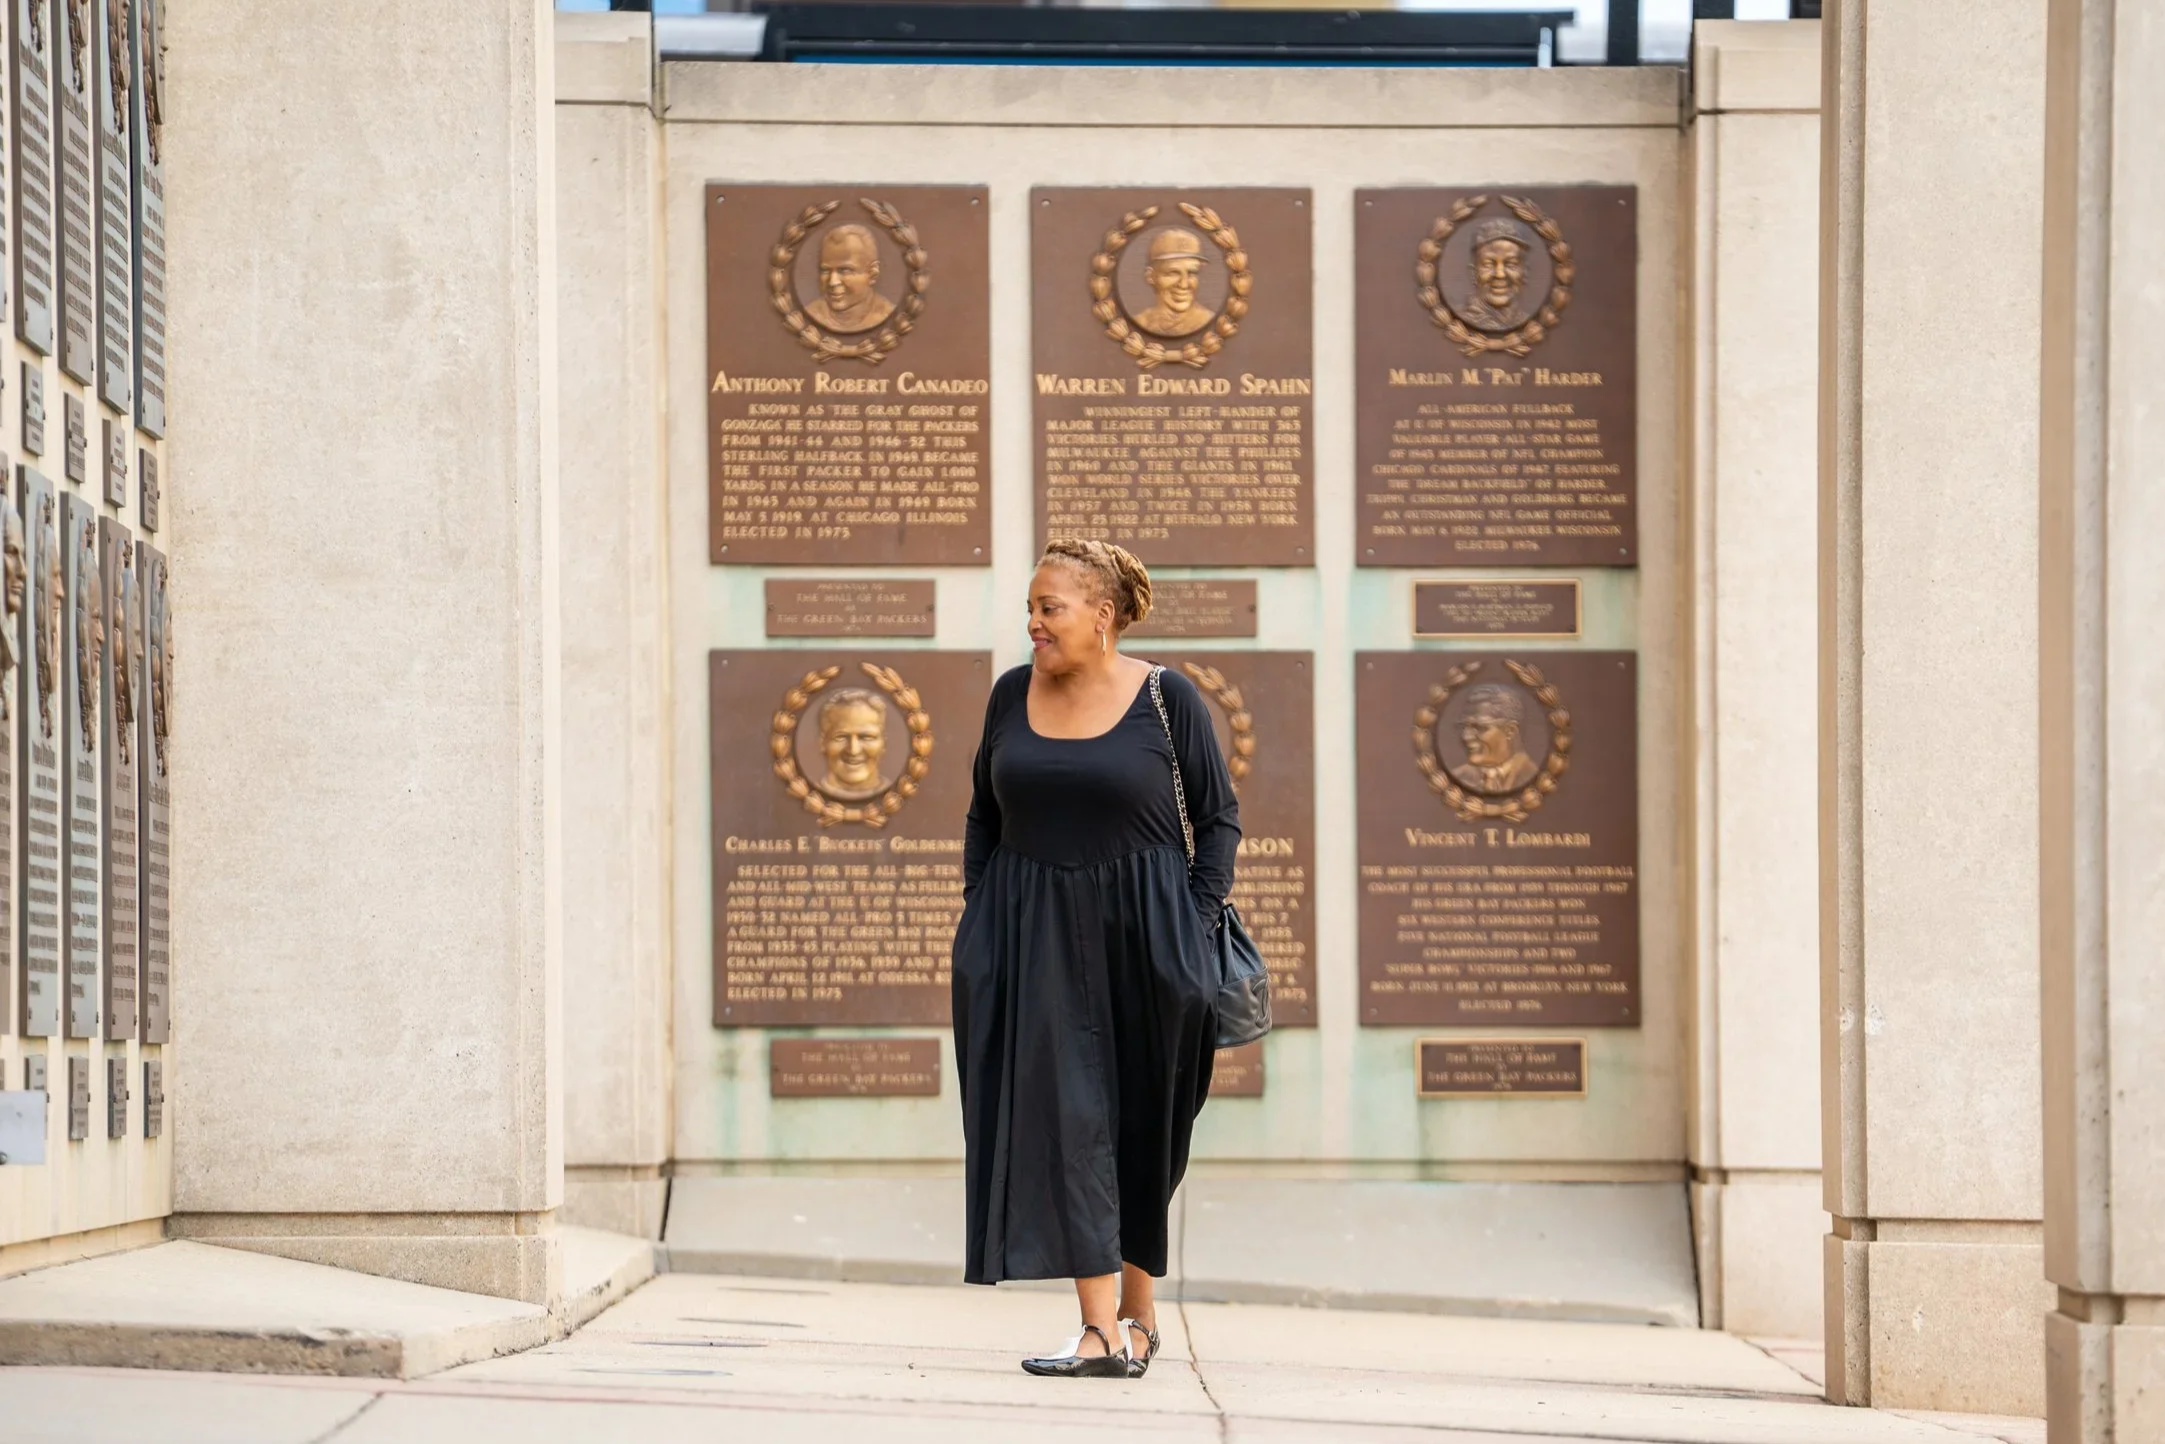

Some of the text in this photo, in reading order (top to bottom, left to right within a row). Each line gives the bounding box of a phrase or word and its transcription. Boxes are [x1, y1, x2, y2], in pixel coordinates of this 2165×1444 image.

[712, 371, 988, 394] ANTHONY ROBERT CANADEO
[1036, 374, 1310, 395] WARREN EDWARD SPAHN
[749, 404, 978, 416] KNOWN AS GRAY GHOST OF
[1280, 406, 1300, 417] OF
[867, 421, 892, 432] FOR
[896, 421, 920, 432] THE
[722, 435, 760, 446] FROM
[831, 436, 862, 447] AND
[722, 450, 788, 462] STERLING
[869, 451, 884, 462] IN
[723, 465, 933, 477] THE FIRST PACKER TO GAIN
[1108, 461, 1139, 471] AND
[1147, 461, 1173, 471] THE
[724, 480, 766, 491] YARDS
[771, 480, 786, 491] IN
[790, 481, 800, 491] A
[880, 481, 918, 493] MADE
[723, 496, 976, 508] IN AND AGAIN IN BORN
[1109, 501, 1139, 512] AND
[724, 511, 752, 522] MAY
[811, 512, 828, 522] AT
[723, 526, 812, 538] ELECTED IN
[1506, 828, 1590, 847] LOMBARDI
[725, 837, 792, 853] CHARLES
[890, 837, 964, 853] GOLDENBE
